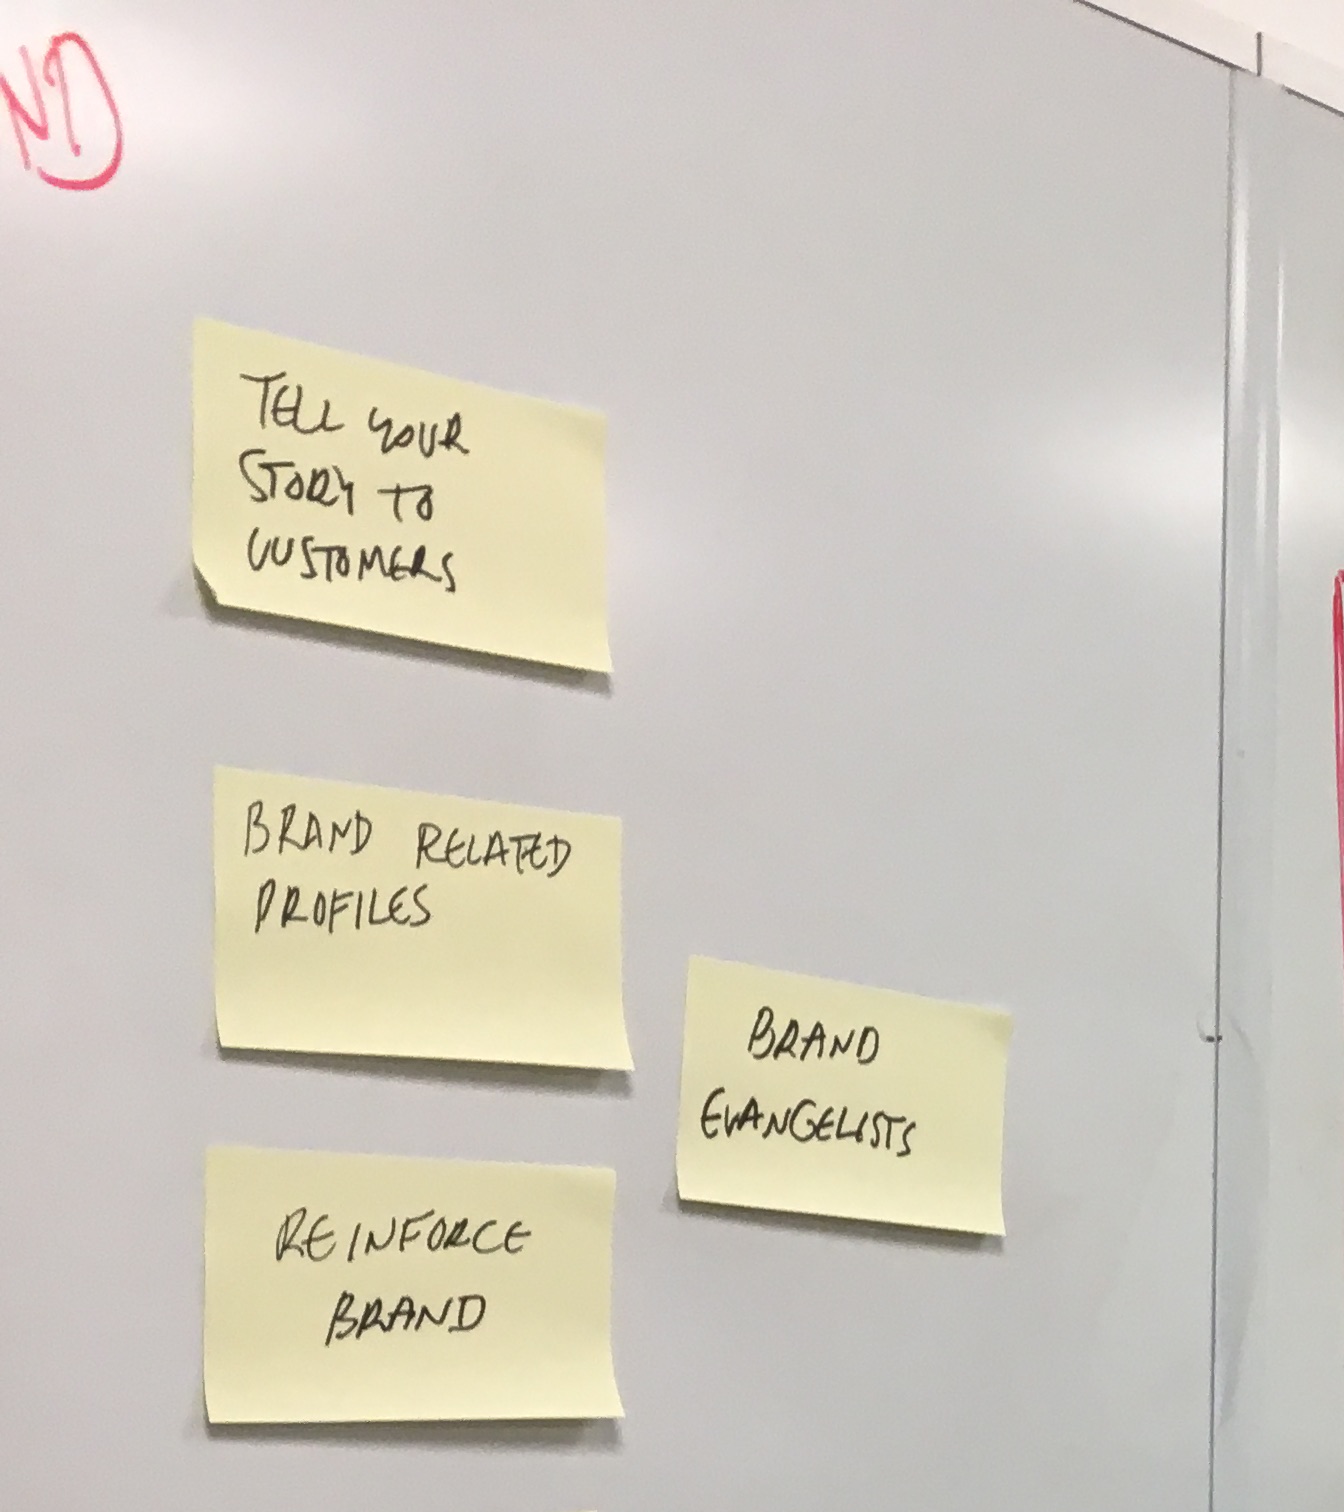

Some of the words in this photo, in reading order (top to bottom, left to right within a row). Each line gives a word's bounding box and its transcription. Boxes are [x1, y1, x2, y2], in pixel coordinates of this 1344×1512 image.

[240, 371, 345, 434] TELL
[368, 406, 471, 458] YOUR
[240, 448, 356, 516] STORY
[377, 484, 434, 522] TO
[248, 528, 457, 593] CUSTOMERS
[244, 800, 372, 859] BRAND
[415, 822, 572, 878] RELATED
[255, 880, 432, 934] PROFILES
[746, 1005, 880, 1065] BRAND
[700, 1088, 918, 1159] EVANGELISTS
[275, 1207, 532, 1264] REINFORCE
[325, 1292, 488, 1347] BRAND
